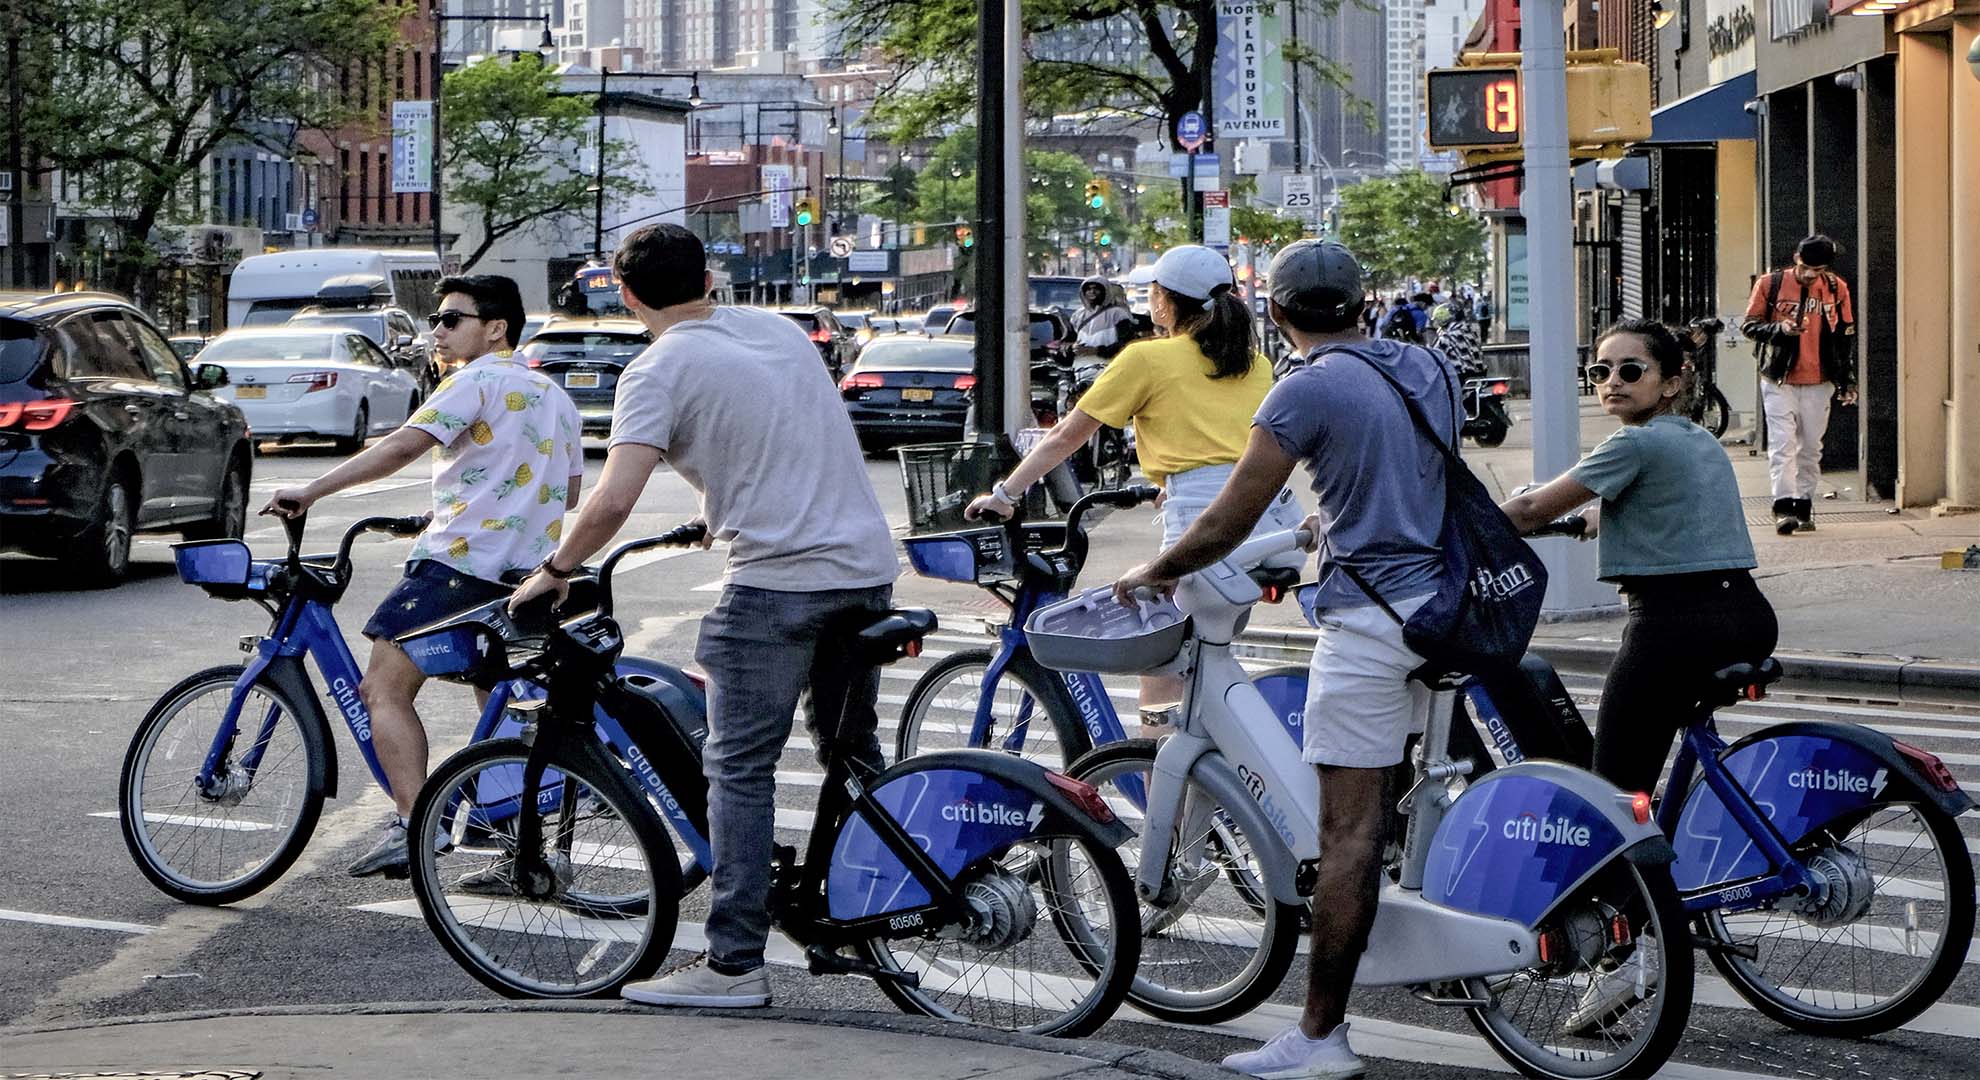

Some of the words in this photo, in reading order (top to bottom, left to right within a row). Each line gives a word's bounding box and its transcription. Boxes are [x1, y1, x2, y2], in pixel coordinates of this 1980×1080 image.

[1245, 17, 1256, 118] FLATBUSH
[1486, 81, 1518, 133] 13
[1223, 120, 1280, 130] AVENUE
[1286, 193, 1311, 206] 25
[1719, 886, 1752, 903] 36008
[890, 913, 924, 930] 80506
